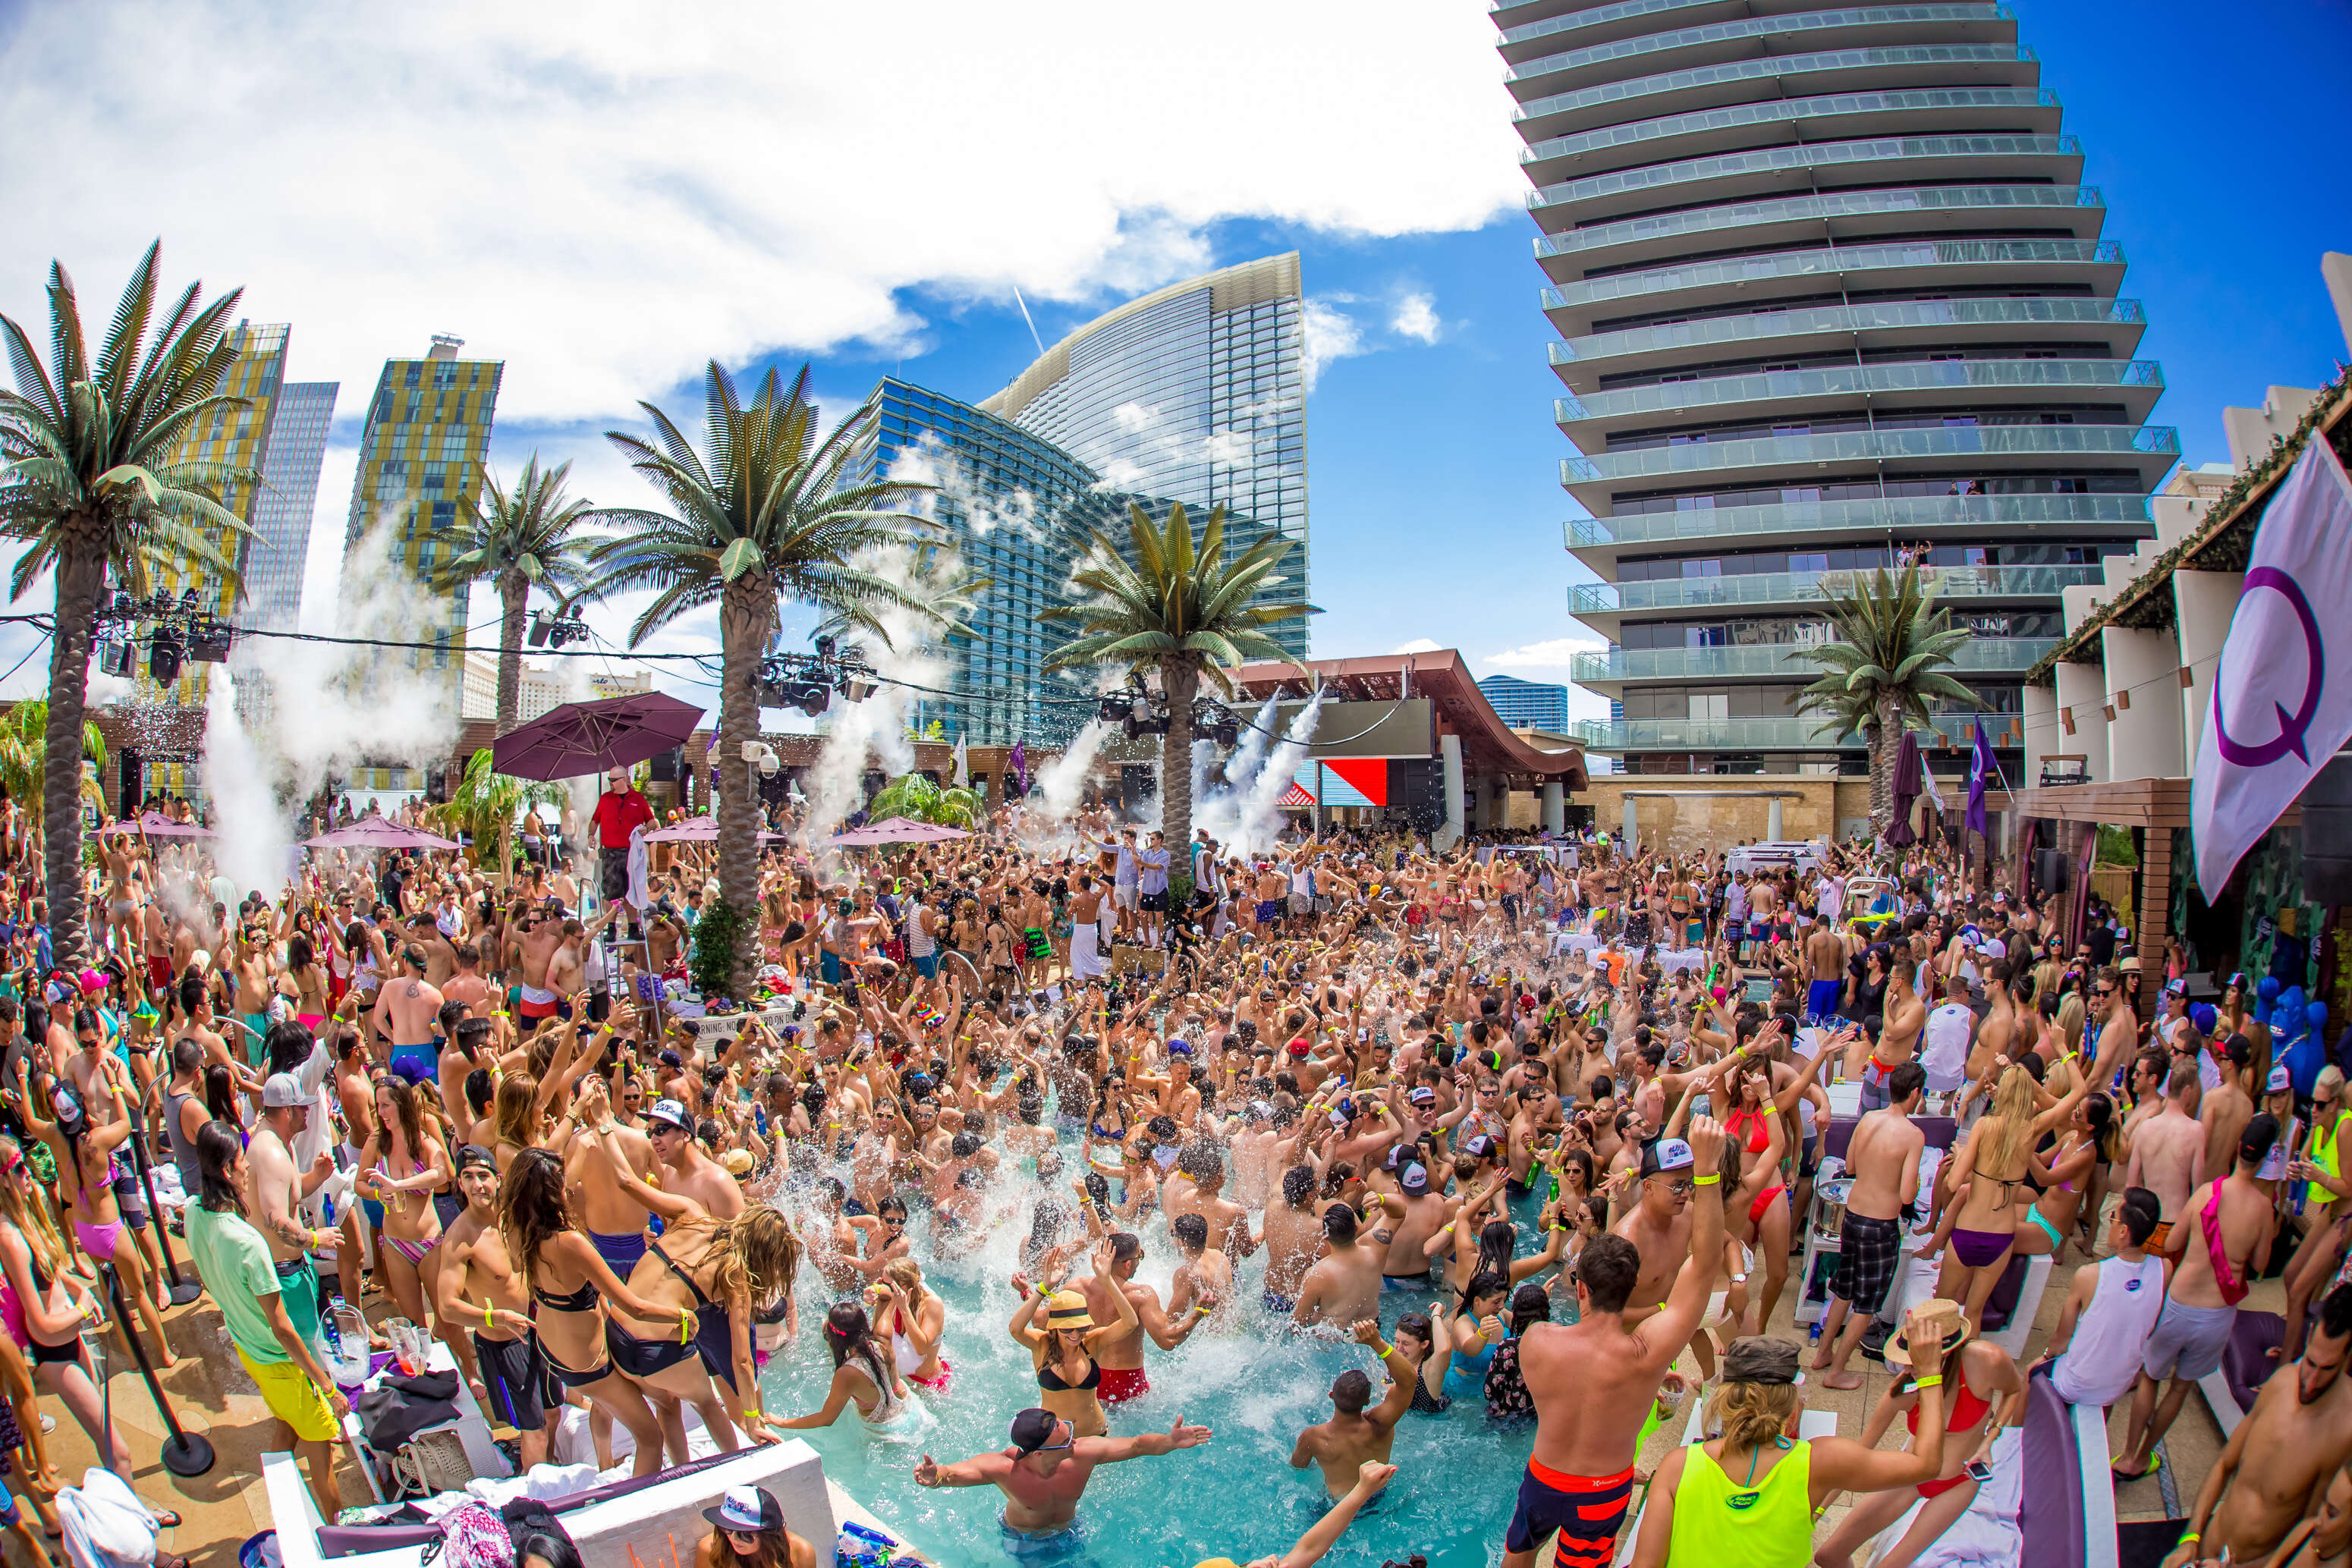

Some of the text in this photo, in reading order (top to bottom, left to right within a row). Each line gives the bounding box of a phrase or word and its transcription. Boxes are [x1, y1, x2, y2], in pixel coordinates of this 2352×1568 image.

[2214, 565, 2324, 767] Q
[449, 763, 461, 775] 14
[726, 1020, 736, 1032] NO
[775, 1015, 785, 1026] ON
